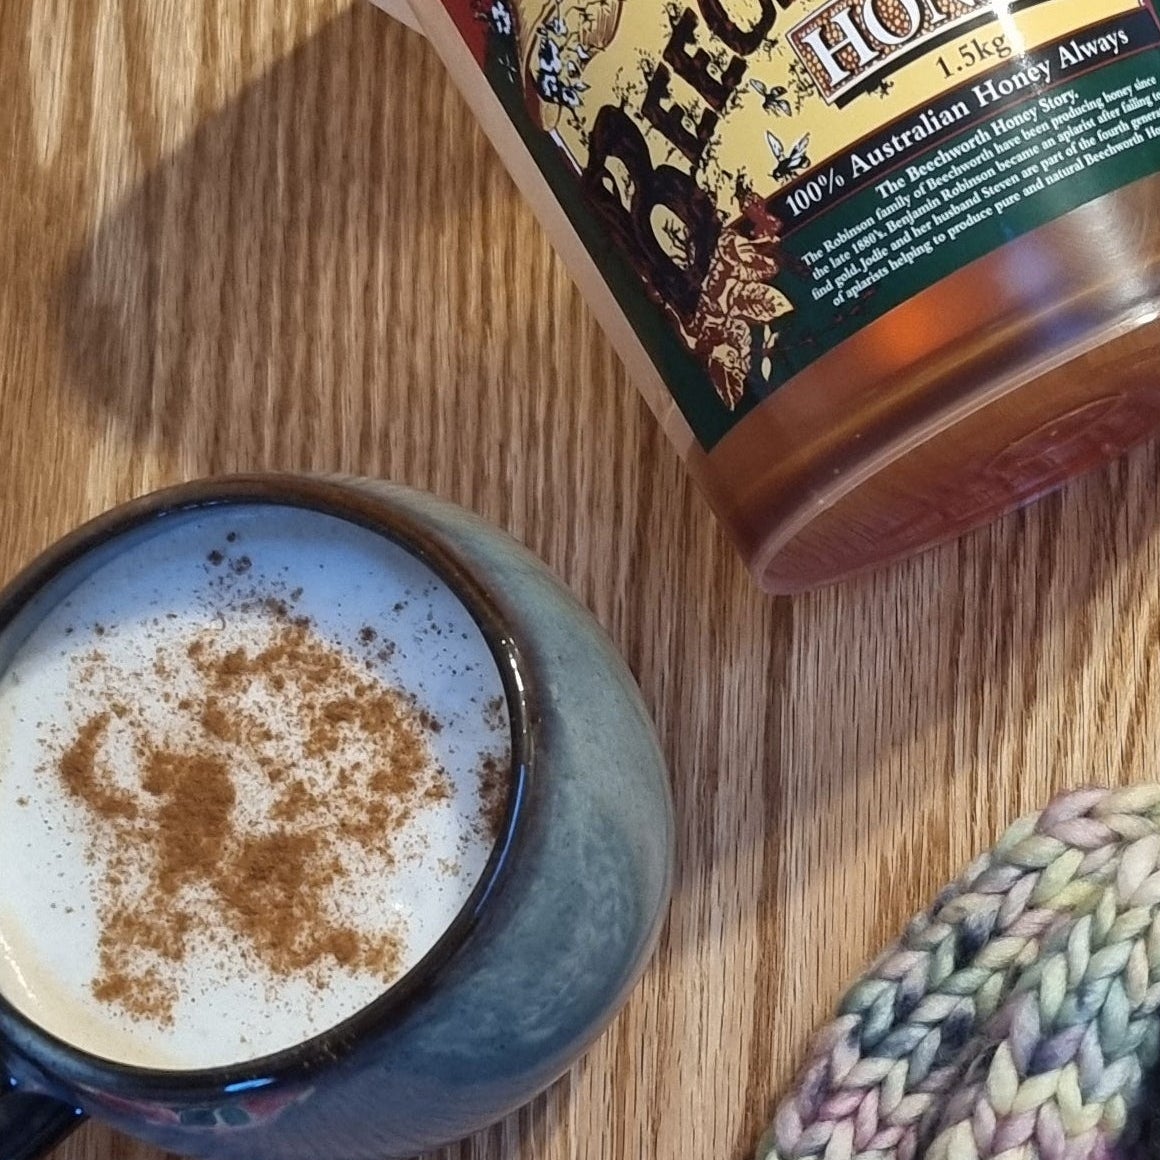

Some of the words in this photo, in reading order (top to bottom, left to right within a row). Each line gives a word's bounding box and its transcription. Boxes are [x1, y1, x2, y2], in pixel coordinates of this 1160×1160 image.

[785, 167, 845, 217] 100%
[850, 99, 970, 179] Australian
[971, 59, 1052, 108] Honey
[1058, 27, 1129, 70] Always
[875, 176, 906, 199] The
[905, 128, 992, 183] Beechworth
[990, 107, 1038, 137] Honey
[1039, 89, 1079, 113] Story.
[935, 34, 1012, 80] 1.5kg
[800, 250, 823, 267] The
[822, 216, 875, 253] Robinson
[875, 194, 912, 221] family
[913, 184, 926, 199] of
[925, 145, 994, 192] Beechworth
[993, 135, 1021, 155] have
[1021, 121, 1049, 141] been
[1050, 96, 1102, 130] producing
[1102, 84, 1133, 104] honey
[1134, 75, 1157, 92] since
[811, 279, 834, 301] find
[834, 263, 862, 289] gold.
[861, 244, 889, 273] Jodie
[890, 231, 912, 251] and
[912, 219, 933, 239] her
[932, 191, 982, 226] husband
[981, 173, 1020, 199] Steven
[1021, 164, 1039, 179] are
[1040, 150, 1064, 172] part
[1065, 141, 1079, 157] of
[1078, 135, 1097, 151] the
[1097, 119, 1130, 143] fourth
[812, 264, 830, 280] the
[829, 250, 851, 269] late
[885, 197, 942, 233] Benjamin
[941, 167, 996, 202] Robinson
[995, 145, 1039, 172] became
[1041, 136, 1057, 150] an
[1057, 117, 1096, 144] apiarist
[1097, 106, 1121, 124] after
[1121, 93, 1153, 114] failing
[832, 290, 845, 307] of
[845, 266, 890, 299] apiarists
[888, 240, 934, 272] helping
[932, 231, 947, 246] to
[947, 205, 993, 241] produce
[994, 193, 1022, 214] pure
[1023, 177, 1045, 197] and
[1045, 156, 1085, 186] natural
[1084, 131, 1144, 167] Beechworth
